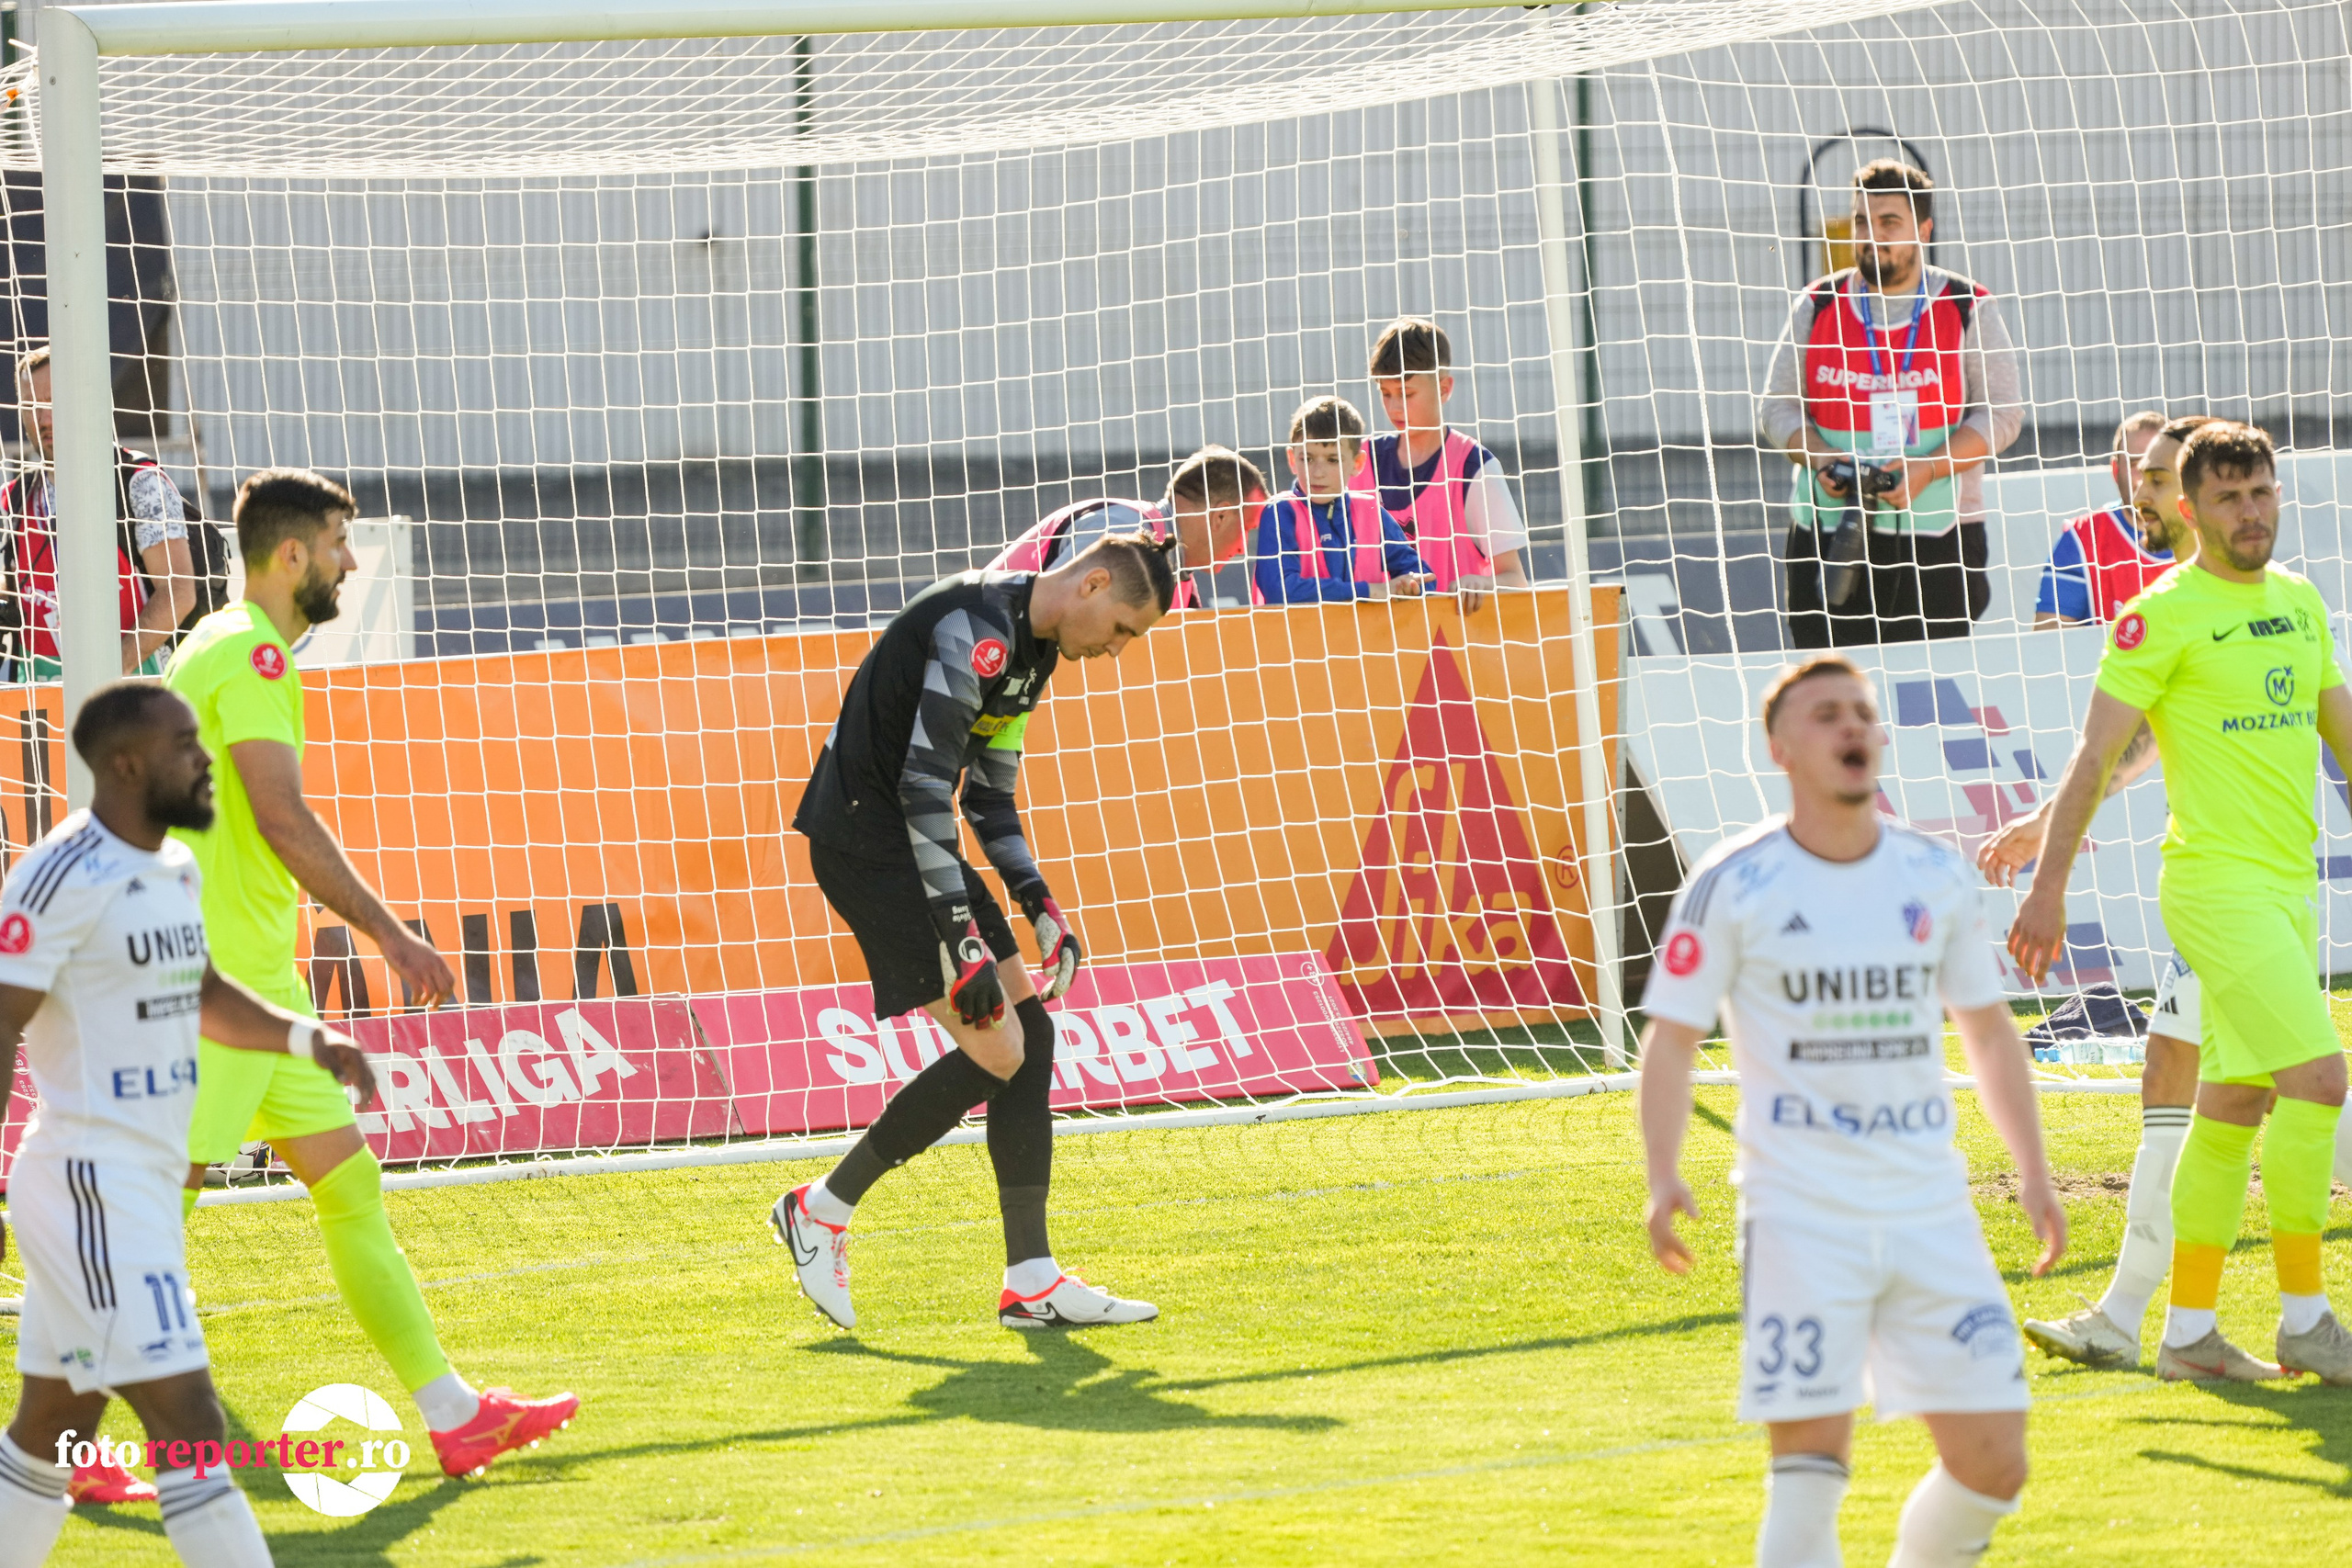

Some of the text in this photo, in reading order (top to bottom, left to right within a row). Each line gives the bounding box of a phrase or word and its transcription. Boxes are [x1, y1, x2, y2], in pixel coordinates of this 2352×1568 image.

[1815, 365, 1939, 390] SUPERLIGA
[2222, 711, 2302, 732] MOZZART
[1340, 763, 1532, 986] Sika
[127, 922, 207, 965] UNIBE
[1782, 964, 1936, 1003] UNIBET
[816, 978, 1256, 1089] SURBET
[1771, 1092, 1947, 1137] ELSACO
[144, 1271, 187, 1331] 11
[1758, 1314, 1825, 1378] 33
